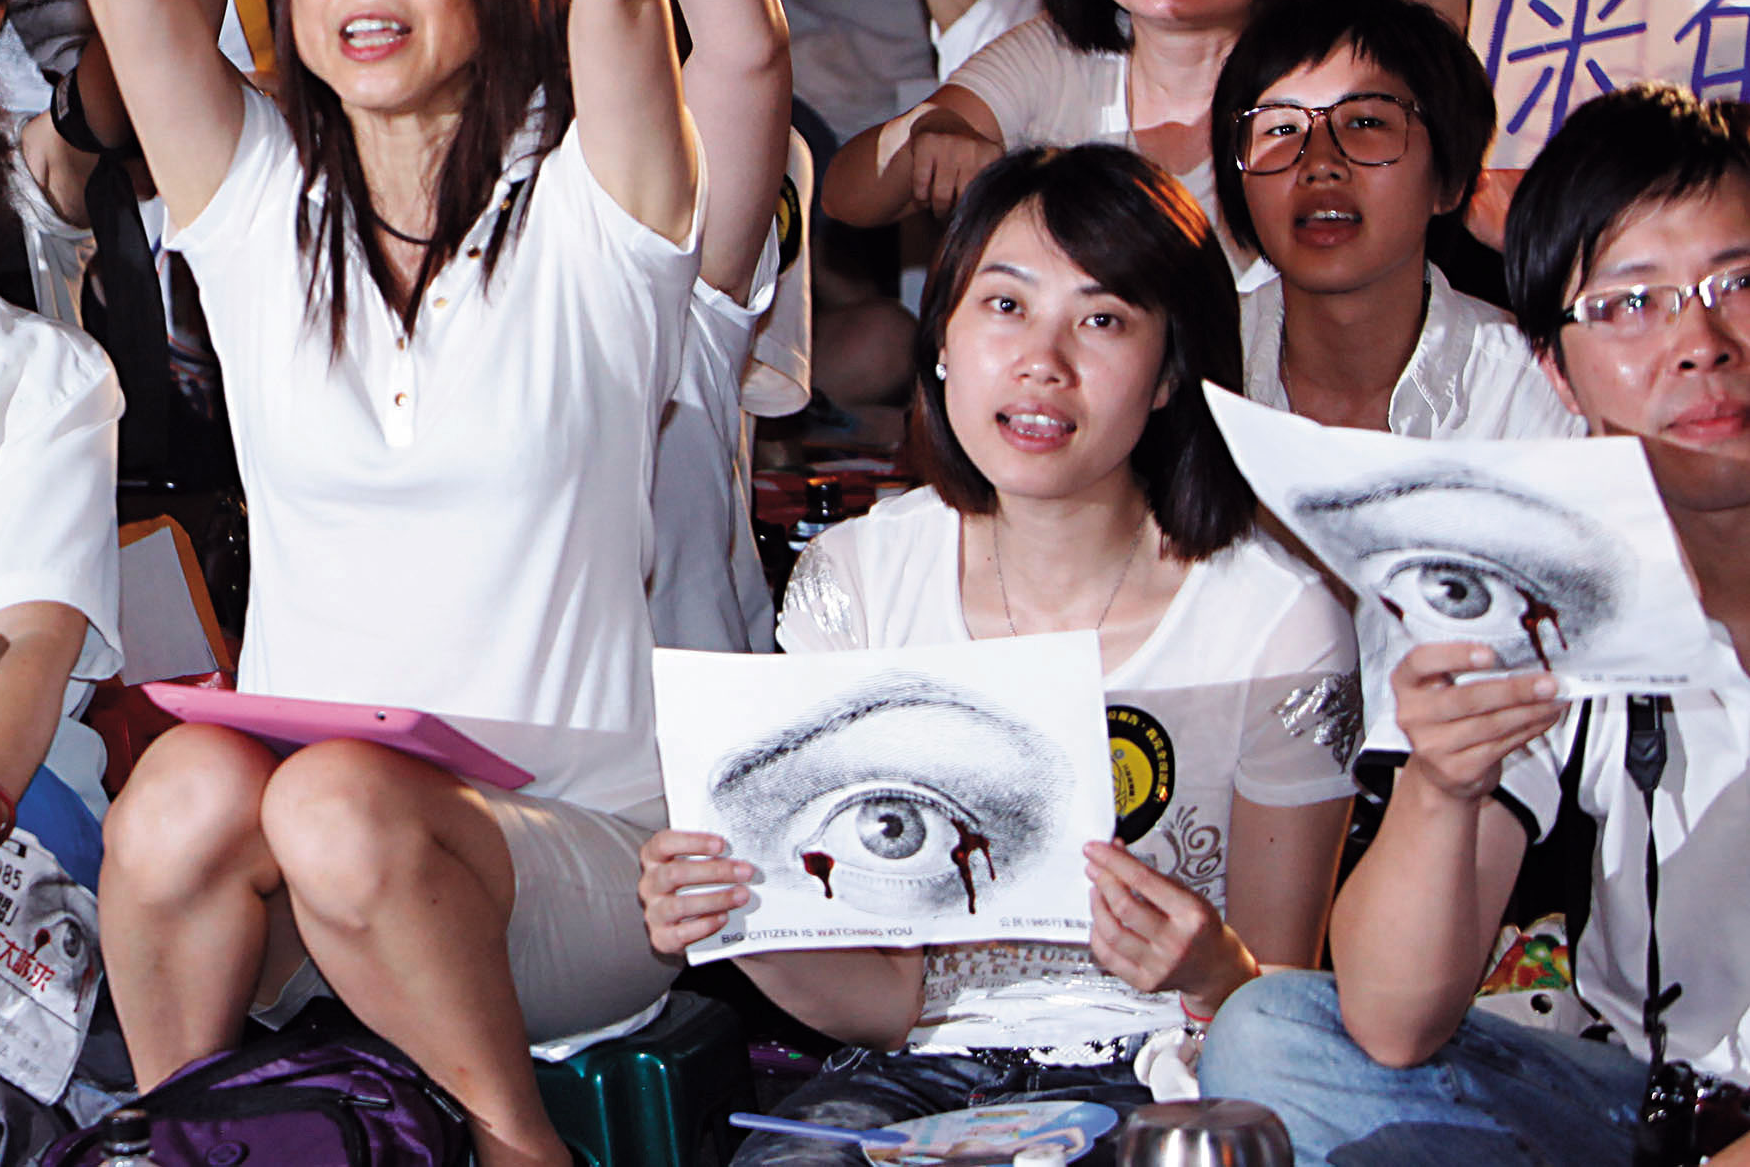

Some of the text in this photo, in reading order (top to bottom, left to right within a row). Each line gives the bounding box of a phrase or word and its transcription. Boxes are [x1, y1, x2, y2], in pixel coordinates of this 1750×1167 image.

[721, 925, 913, 944] BIG CITIZEN IS WATCHING YOU
